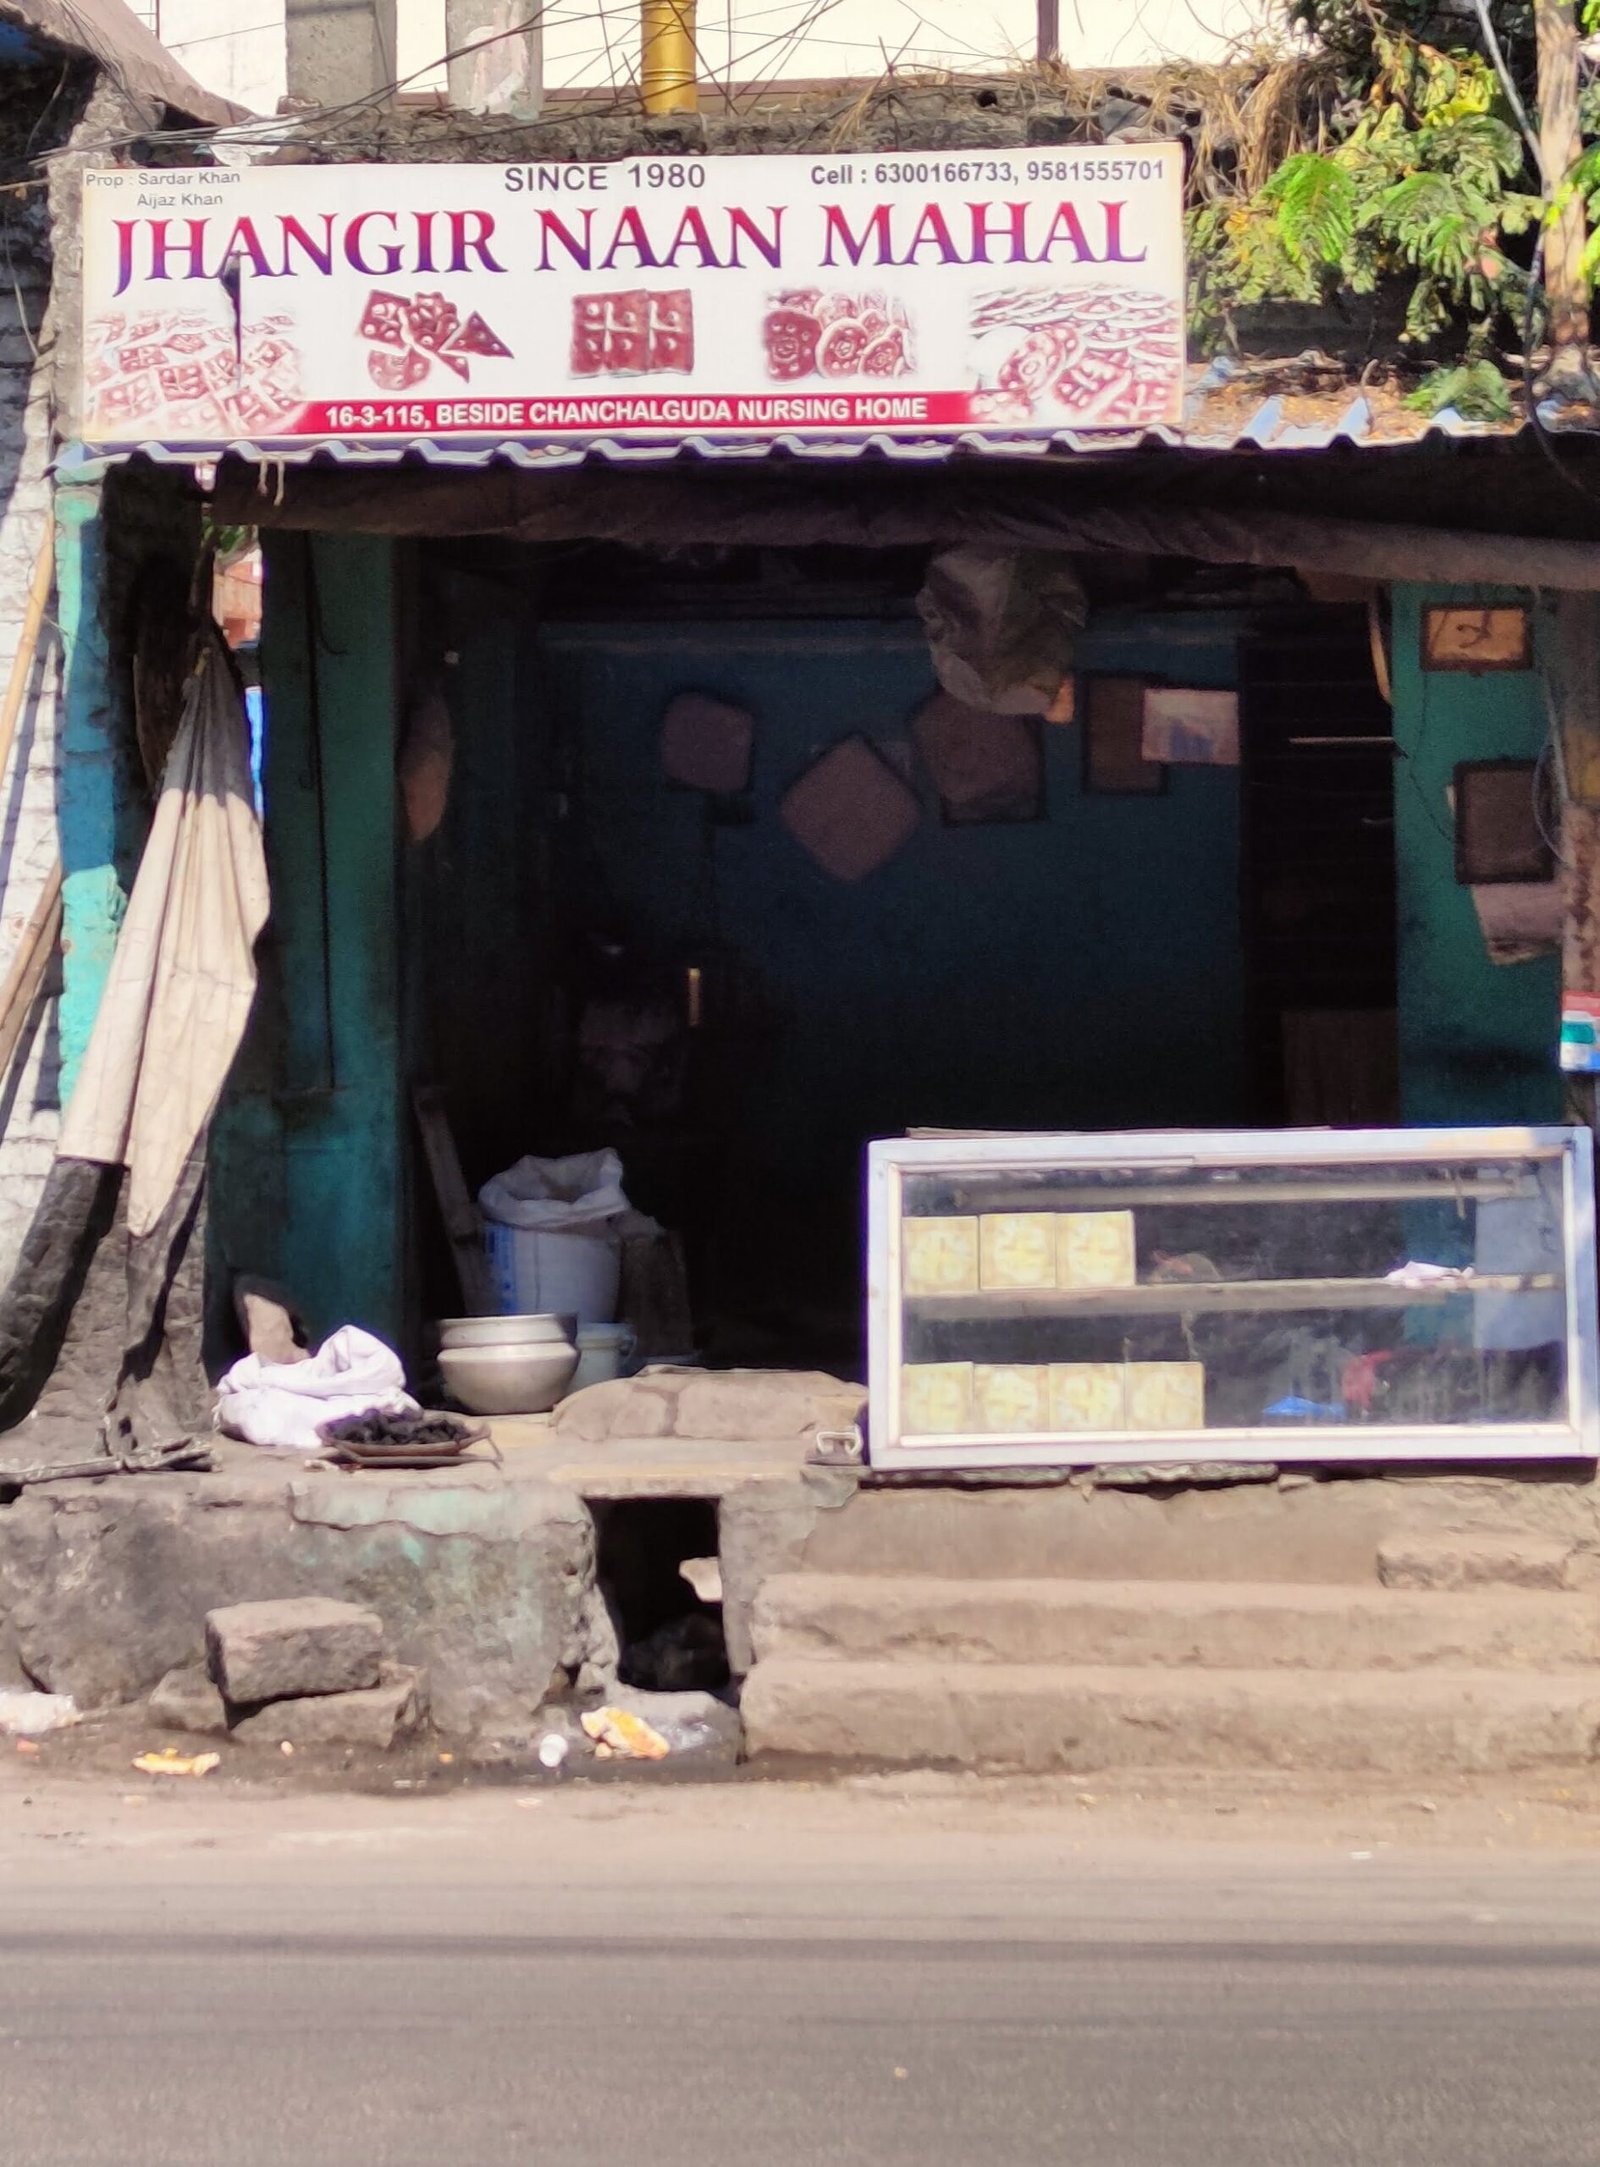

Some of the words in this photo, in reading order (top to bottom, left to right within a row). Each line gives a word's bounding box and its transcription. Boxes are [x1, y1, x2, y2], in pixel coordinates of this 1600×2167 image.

[86, 174, 124, 188] Prop
[138, 172, 194, 185] Sardar
[198, 171, 241, 184] Khan
[504, 166, 608, 192] SINCE
[626, 163, 706, 189] 1980
[810, 165, 853, 184] Cell
[874, 162, 1019, 185] 6300166733,
[1026, 159, 1164, 181] 9581555701
[137, 193, 175, 209] Aijaz
[181, 193, 224, 206] Khan
[112, 208, 508, 298] JHANGIR
[533, 204, 789, 271] NAAN
[818, 200, 1148, 267] MAHAL
[325, 405, 431, 429] 16-3-115,
[436, 402, 523, 425] BESIDE
[529, 399, 732, 424] CHANCHALGUDA
[737, 399, 850, 421] NURSING
[854, 397, 928, 419] HOME
